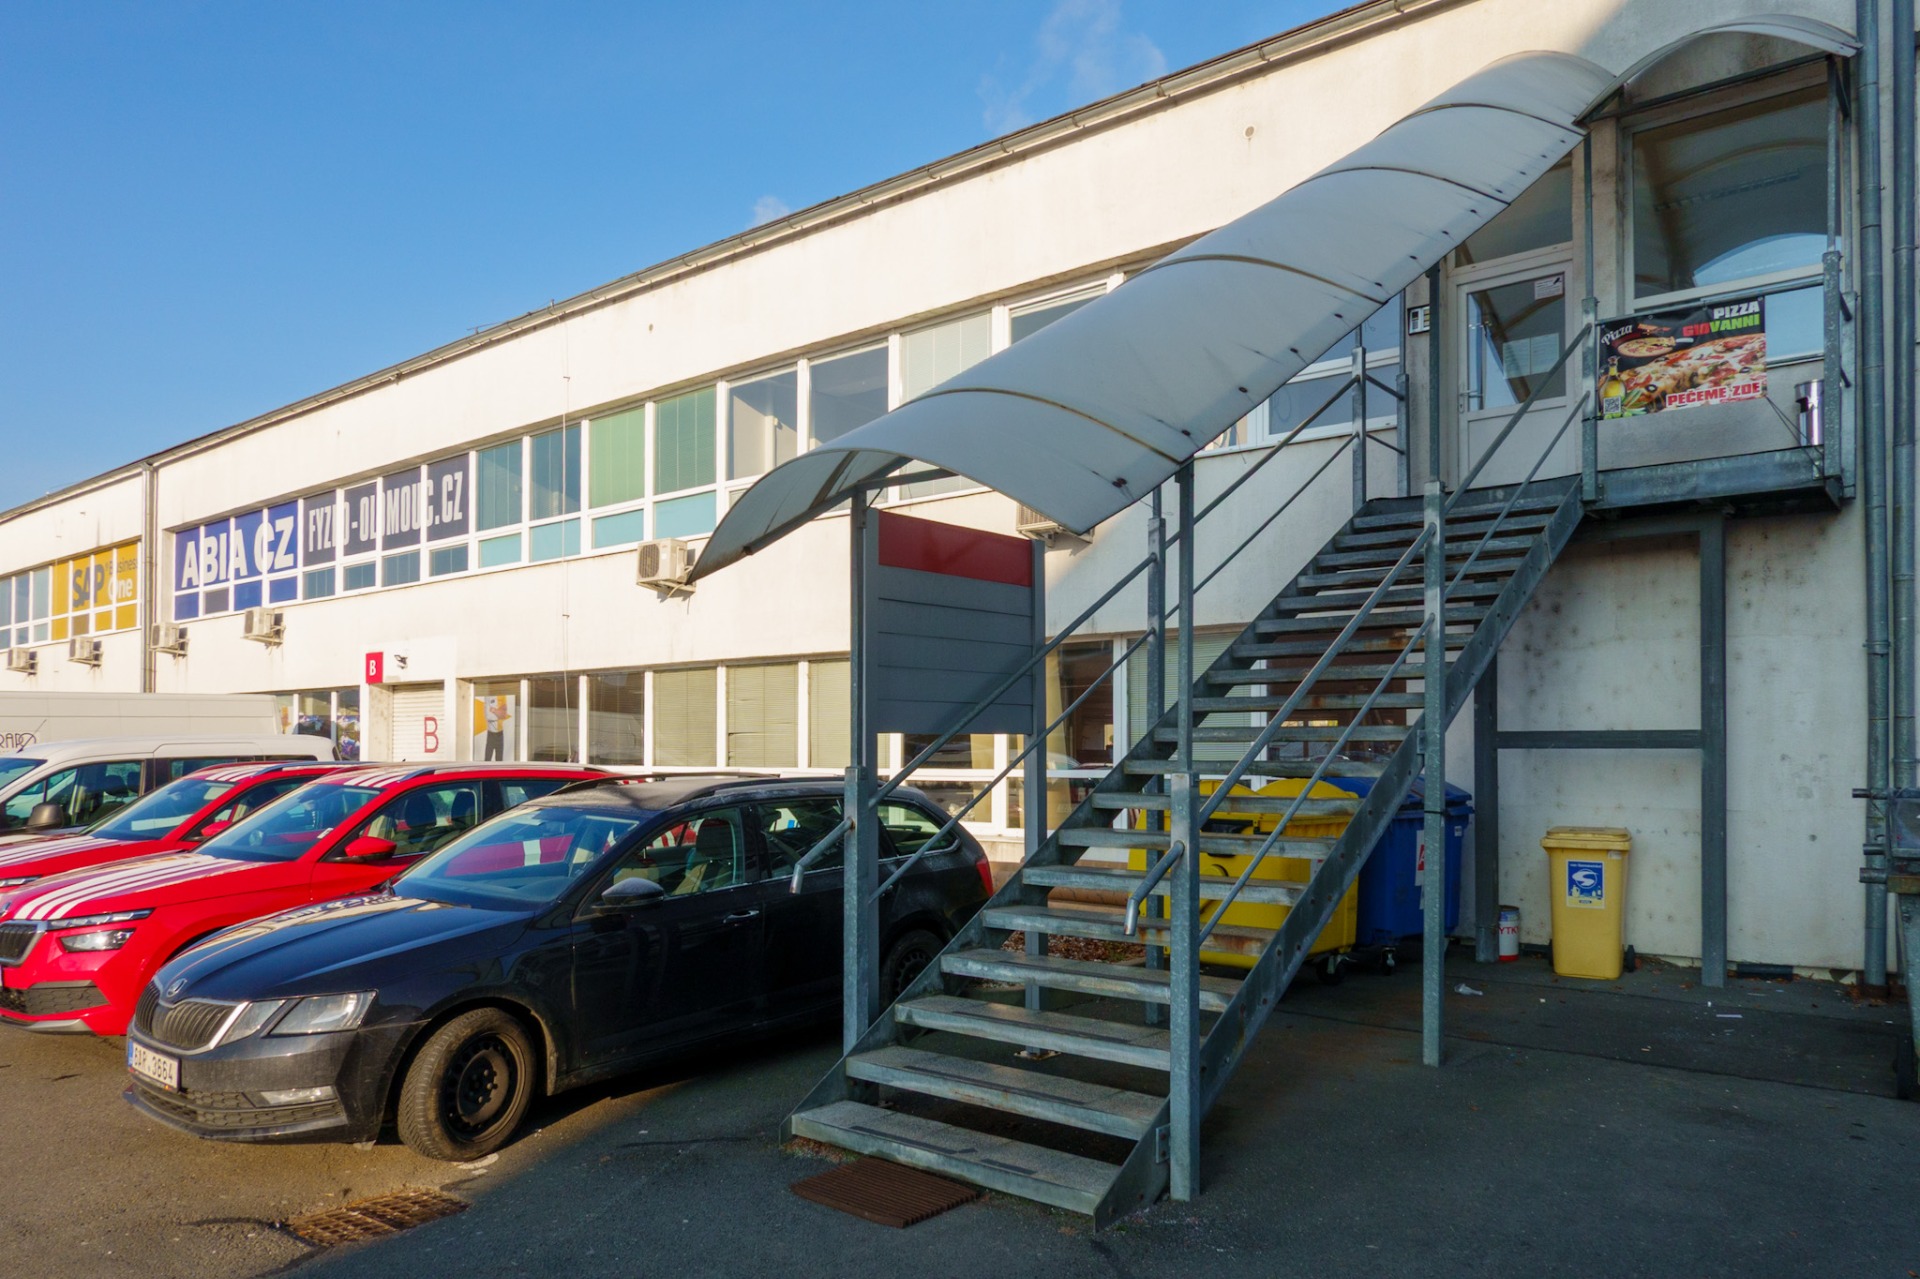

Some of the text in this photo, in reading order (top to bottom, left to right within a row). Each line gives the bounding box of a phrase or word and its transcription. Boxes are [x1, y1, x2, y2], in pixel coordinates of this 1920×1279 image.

[1713, 300, 1760, 320] PIZZA
[1600, 324, 1633, 346] Pizza
[1682, 313, 1760, 337] GIOVANNI
[1667, 387, 1727, 406] PEČEME
[1732, 382, 1760, 396] ZDE
[308, 471, 463, 552] FYZIO-OLMOUC.CZ
[181, 515, 294, 588] ABIA CZ
[72, 564, 105, 608] SAP
[108, 578, 133, 601] One
[369, 659, 377, 677] B
[424, 716, 439, 753] B
